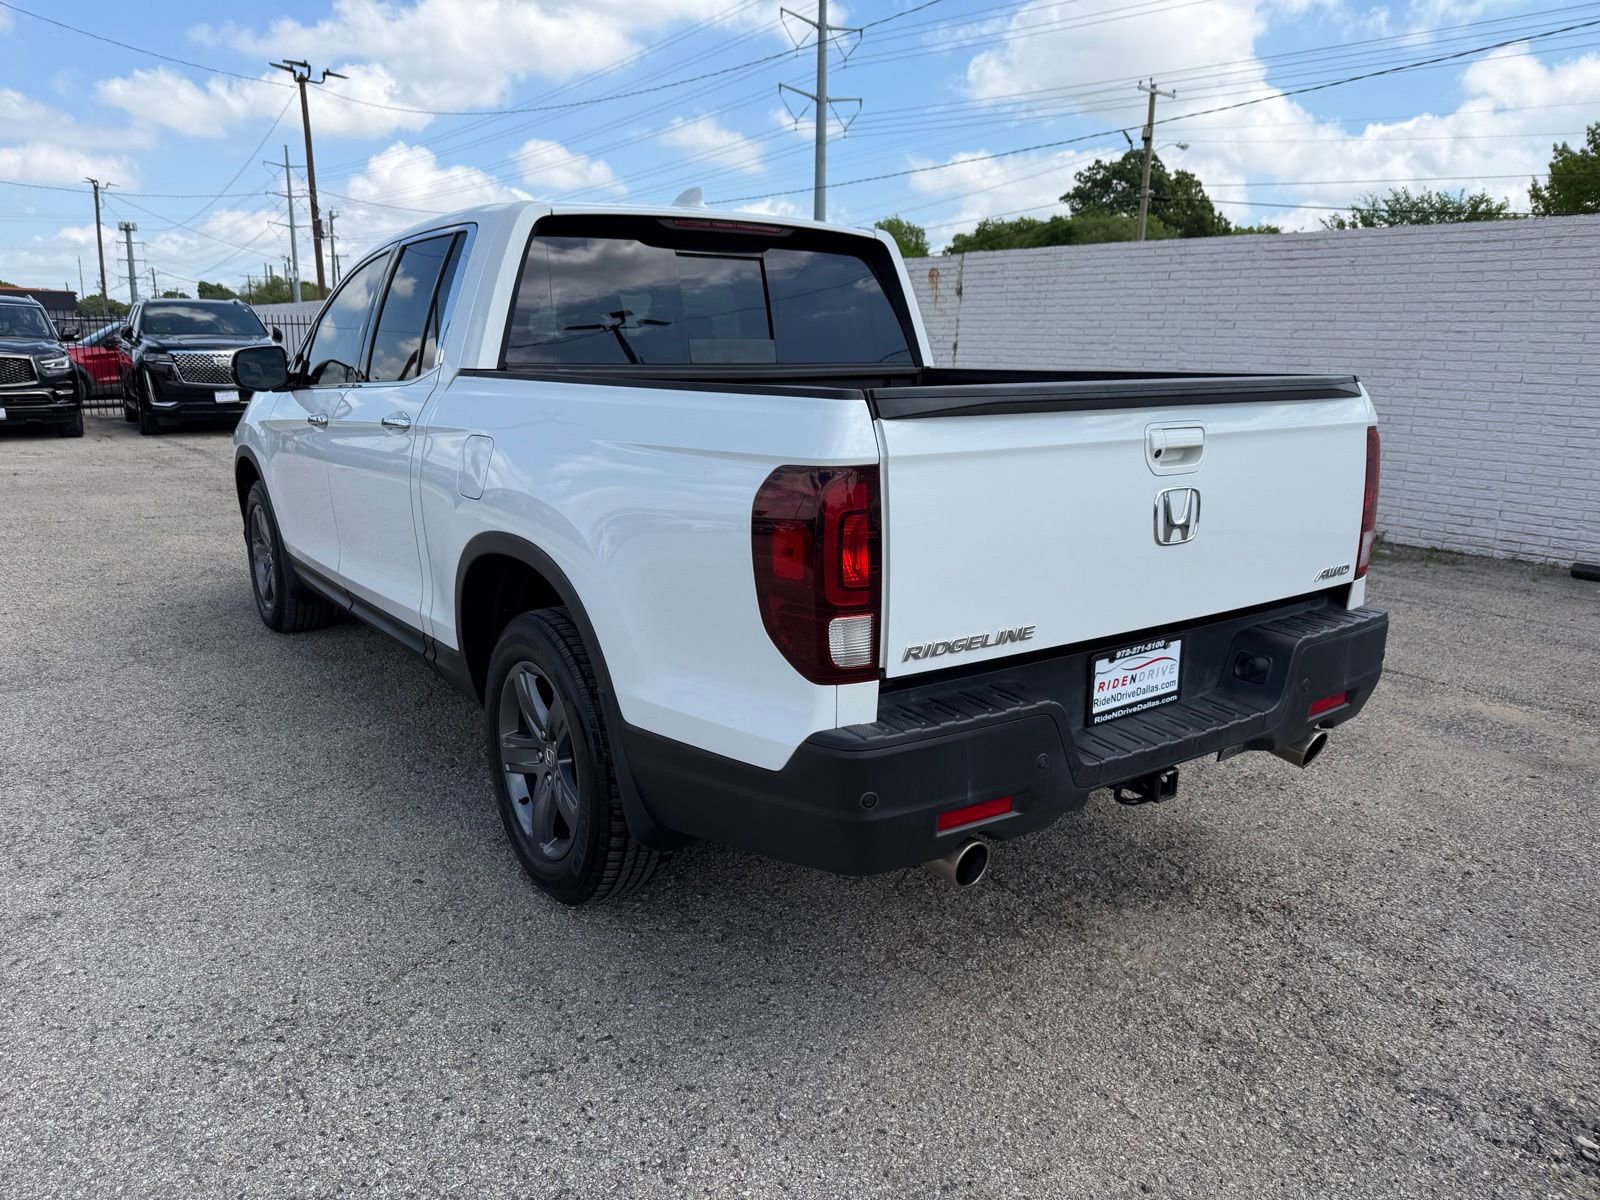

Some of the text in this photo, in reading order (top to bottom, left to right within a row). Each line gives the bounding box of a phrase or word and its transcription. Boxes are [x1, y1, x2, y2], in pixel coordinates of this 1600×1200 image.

[1314, 564, 1350, 582] AWD
[902, 625, 1036, 662] RIDGELINE
[1116, 640, 1165, 658] 972-271-5100
[1097, 664, 1176, 693] RIDENDRIVE
[1093, 679, 1176, 708] RideNDriveDallas.com
[1094, 694, 1178, 724] RideNDriveDallas.com
